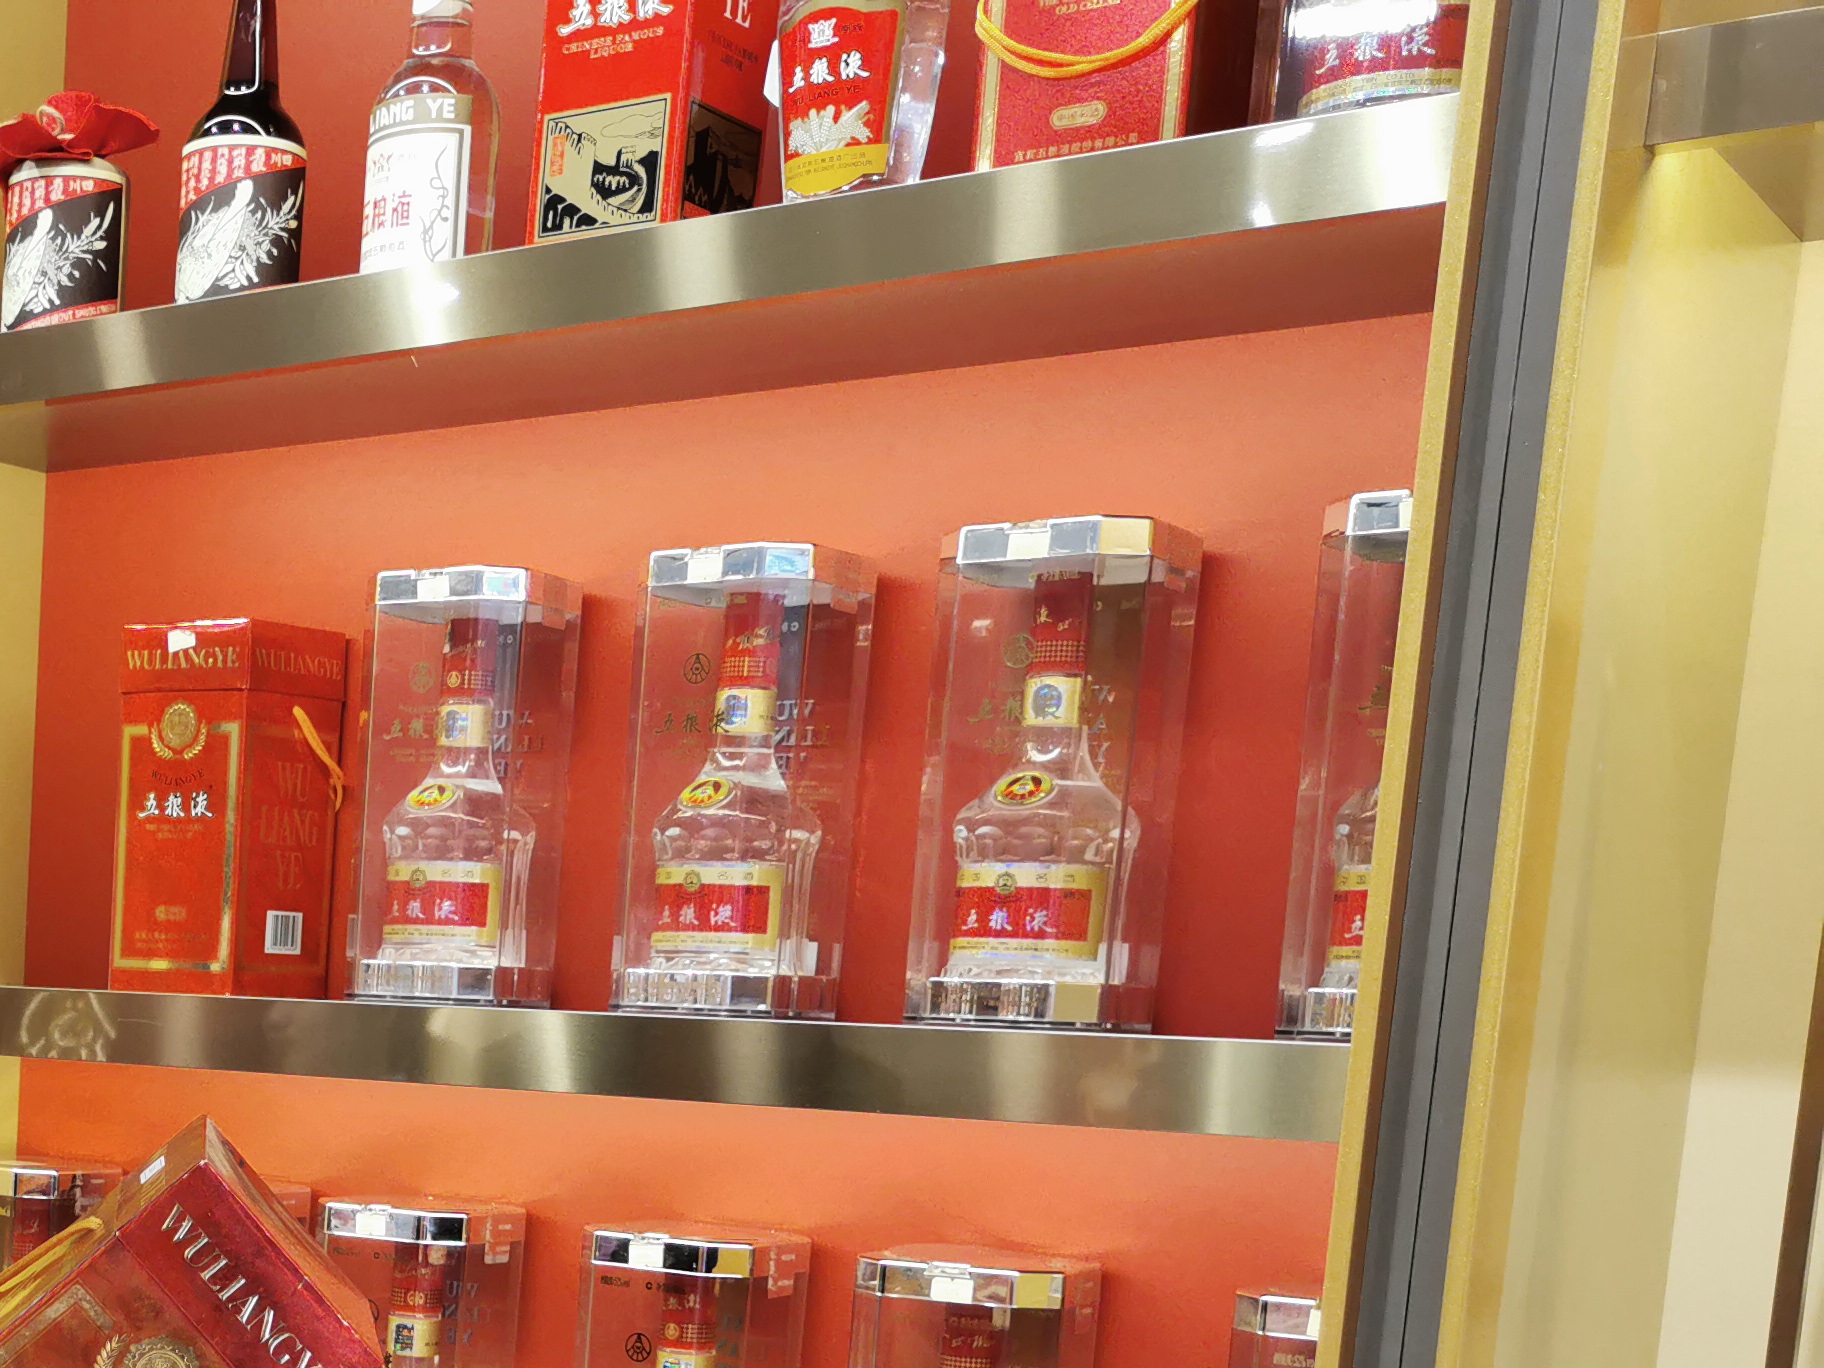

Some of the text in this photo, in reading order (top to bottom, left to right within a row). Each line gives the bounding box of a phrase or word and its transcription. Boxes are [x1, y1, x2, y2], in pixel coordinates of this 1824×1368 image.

[562, 26, 665, 54] CHINESE FAMOUS
[590, 43, 634, 59] LIQUOR
[788, 50, 871, 94] 五粮液
[809, 88, 839, 101] LIANG
[425, 98, 456, 118] YE
[127, 646, 241, 671] WULIANGYE
[255, 648, 342, 681] WULIANGYE
[655, 707, 730, 734] 五粮液
[150, 768, 205, 787] WULIANGYE
[137, 789, 215, 819] 五粮液
[658, 903, 738, 927] 五粮液
[961, 908, 1058, 934] 五粮液
